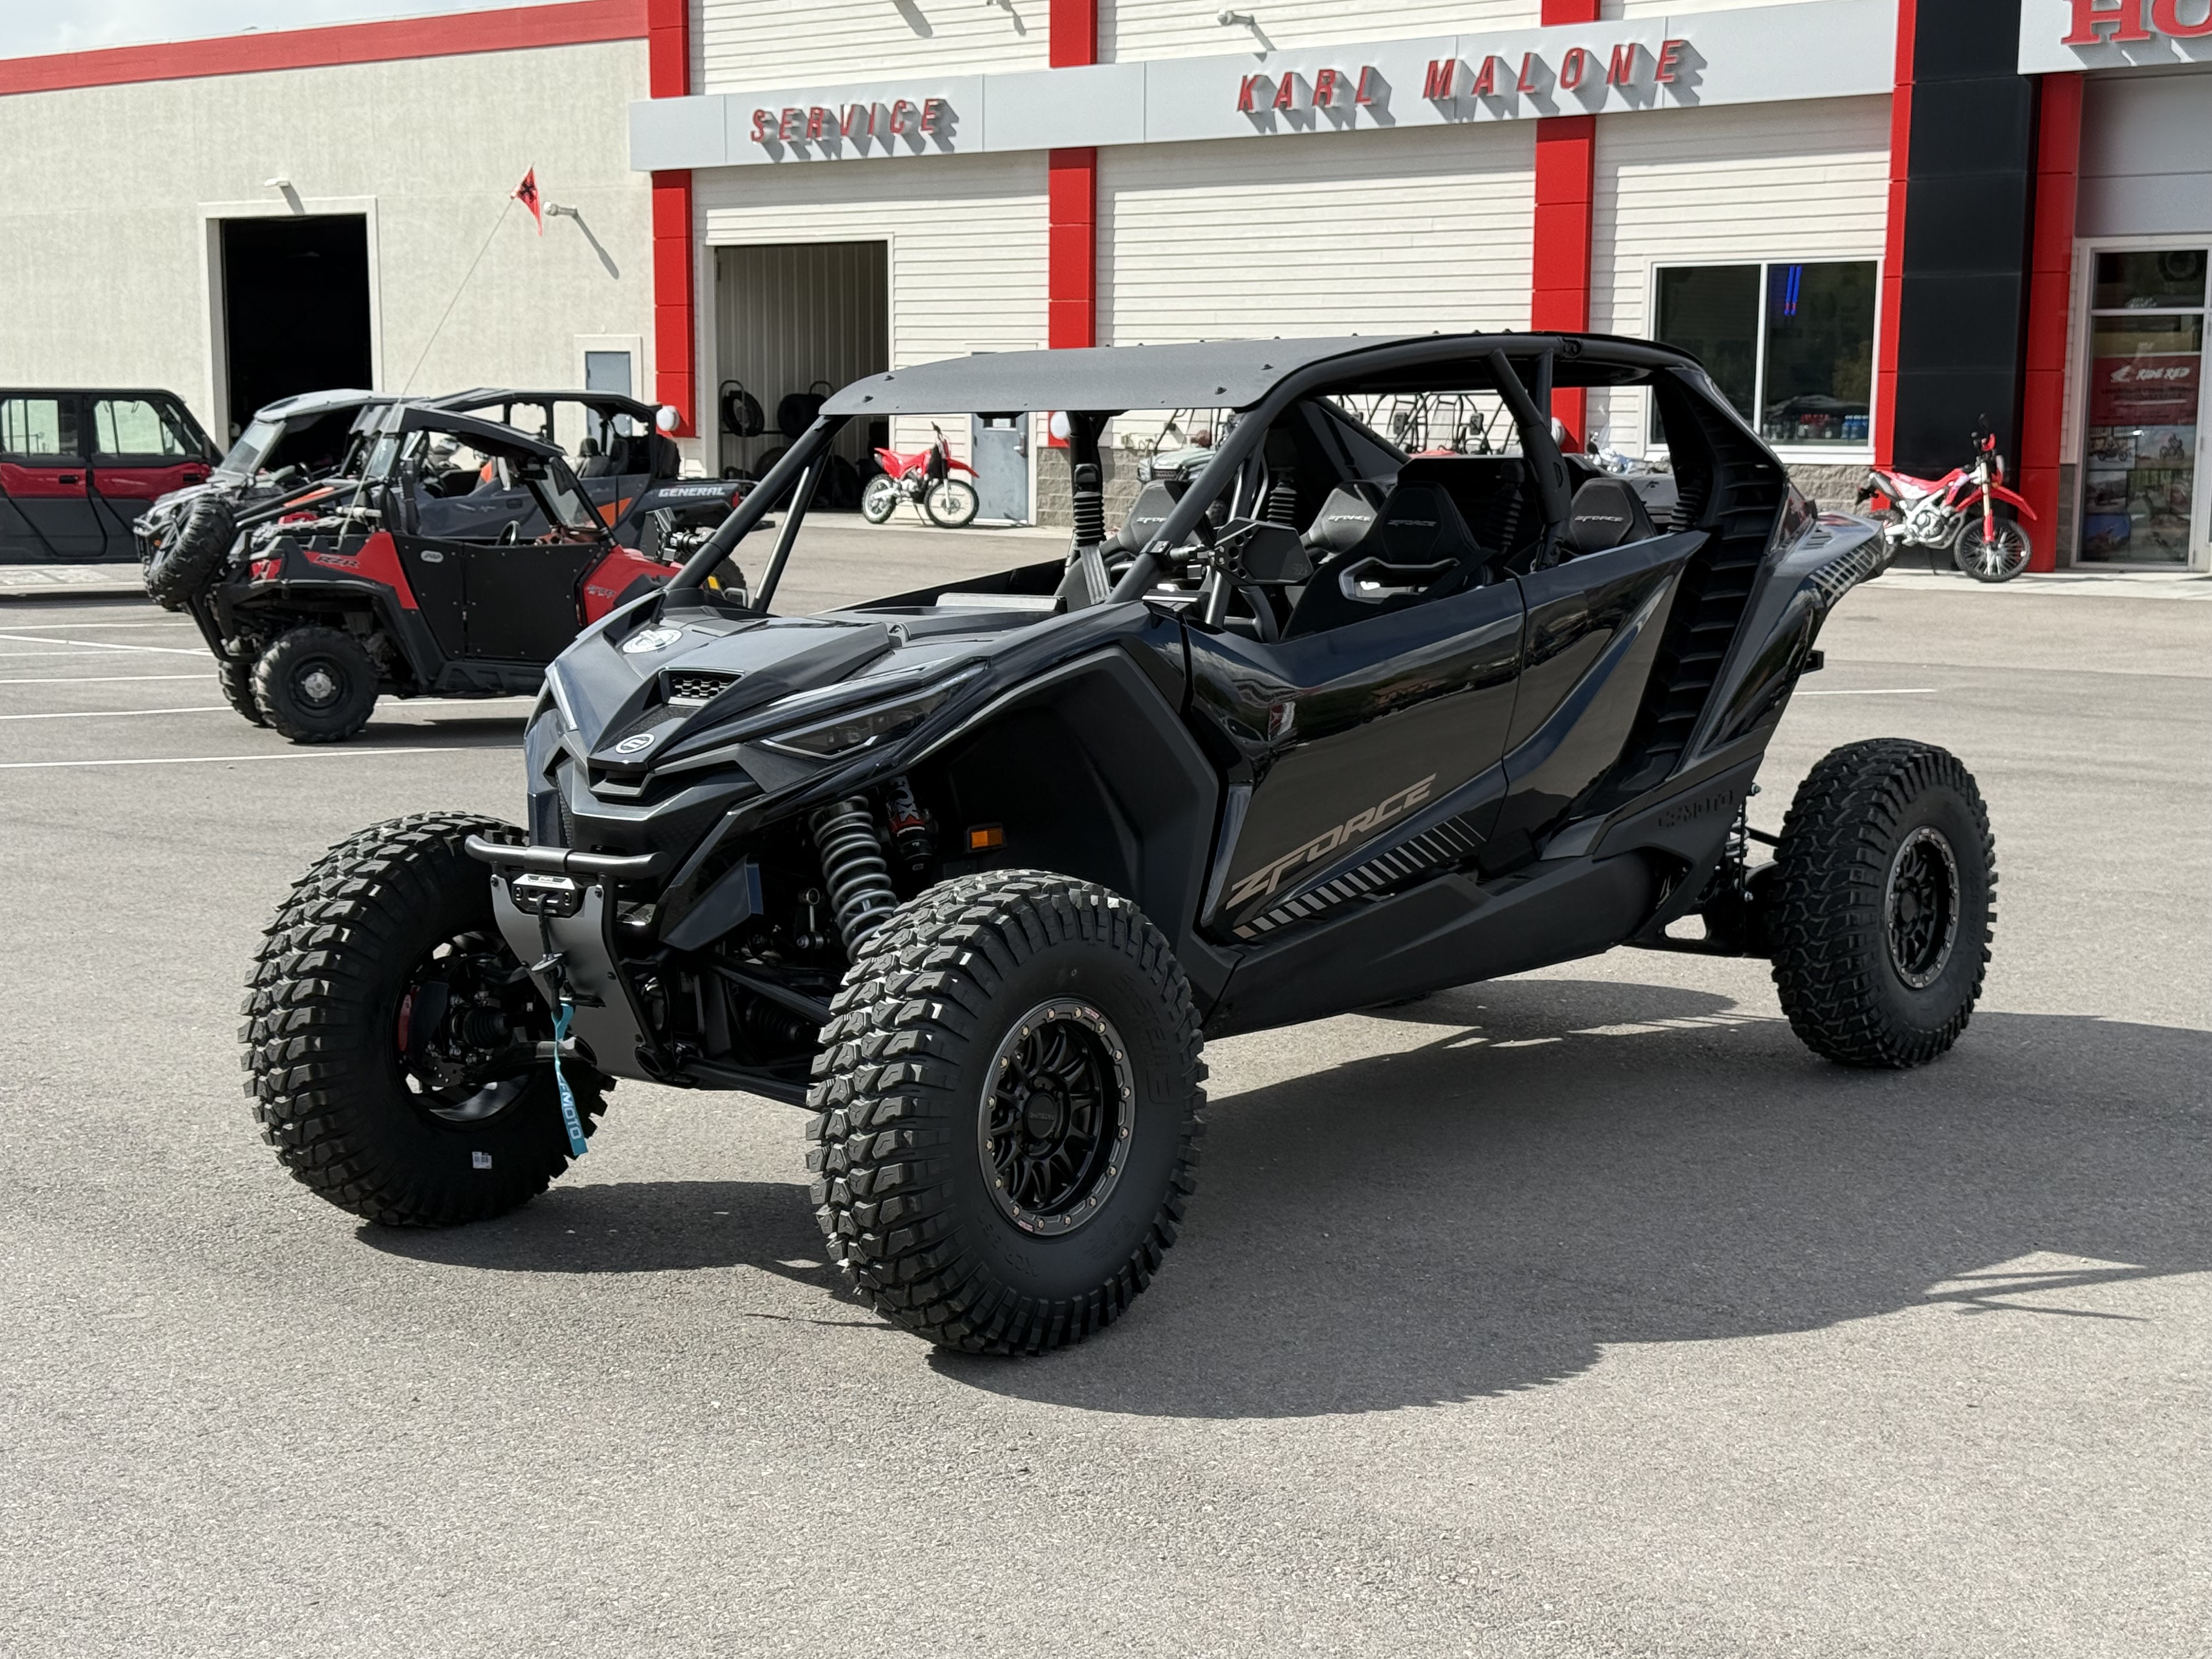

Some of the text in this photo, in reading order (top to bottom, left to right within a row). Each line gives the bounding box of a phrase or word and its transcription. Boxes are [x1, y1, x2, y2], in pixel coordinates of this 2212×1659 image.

[1237, 39, 1685, 114] KARL MALONE
[751, 98, 940, 143] SERVICE
[658, 487, 726, 498] GENERAL
[889, 775, 921, 822] FOX
[1225, 772, 1437, 911] ZFORCE
